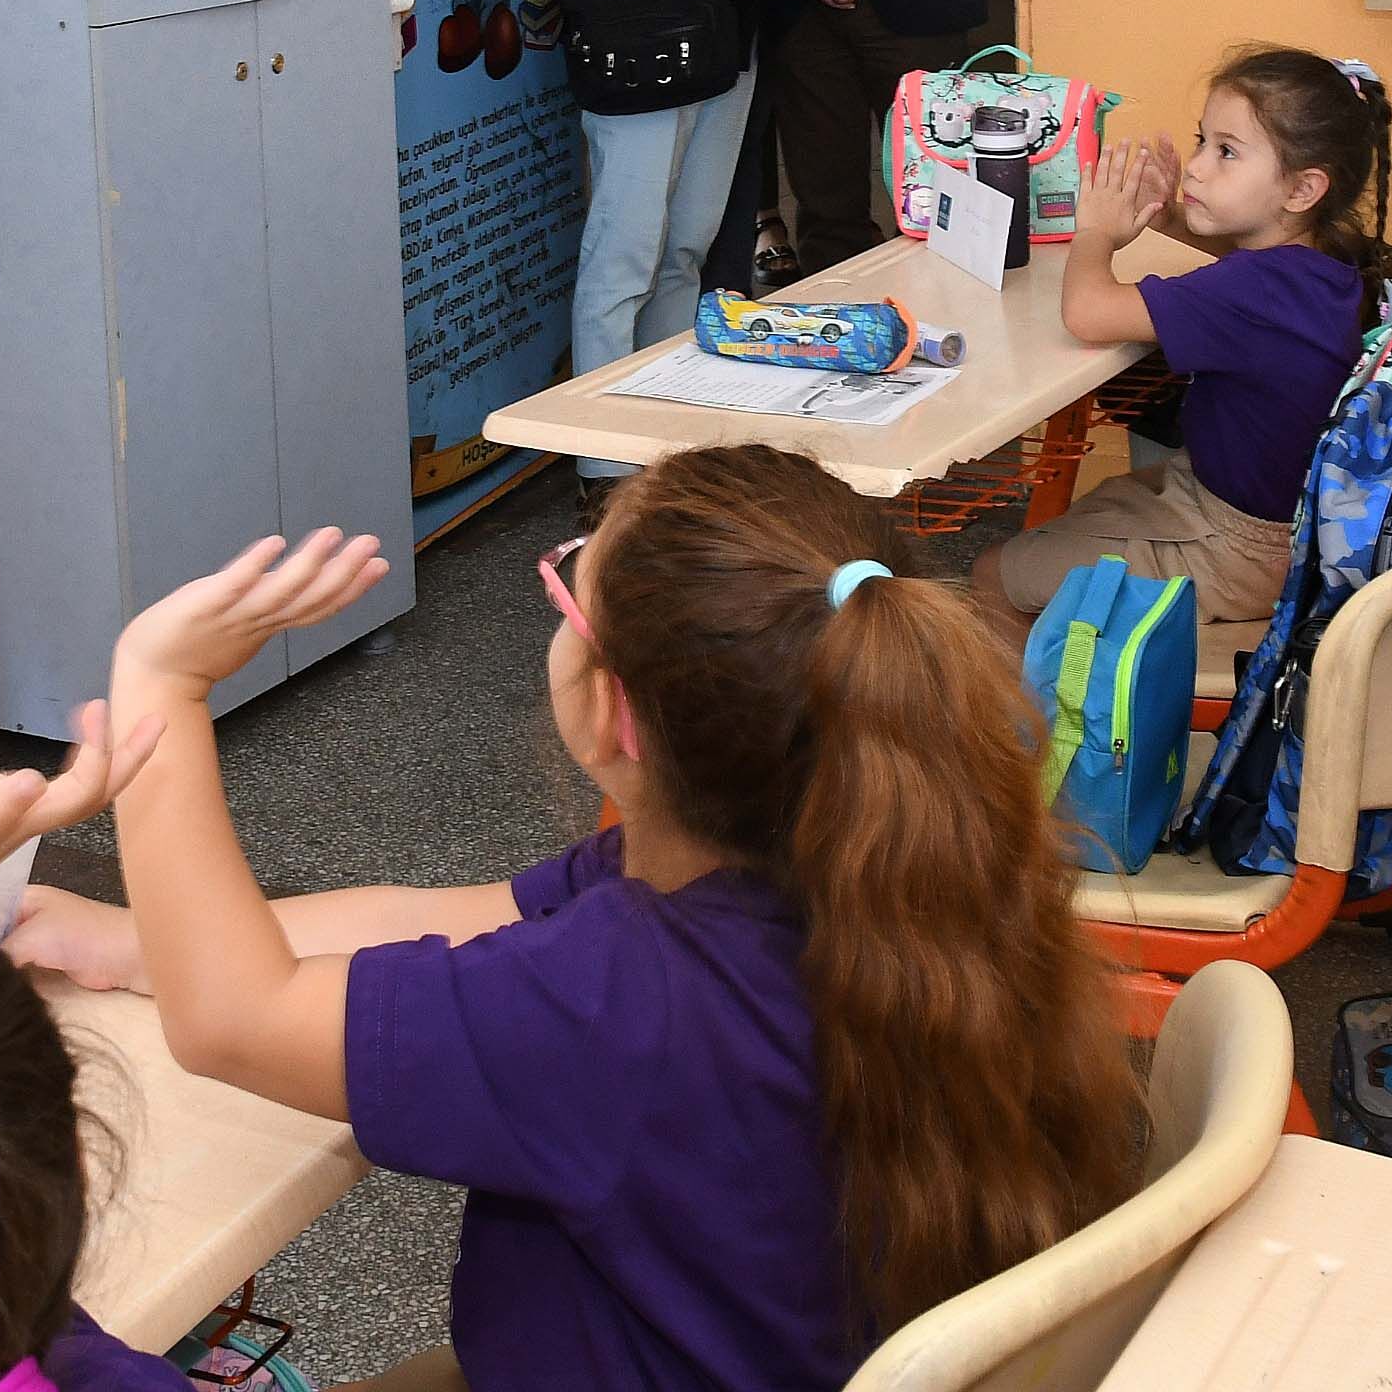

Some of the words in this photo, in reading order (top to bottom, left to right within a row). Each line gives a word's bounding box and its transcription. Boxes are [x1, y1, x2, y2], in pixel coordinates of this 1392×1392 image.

[412, 130, 455, 162] çocukken
[458, 116, 478, 140] uçak
[432, 145, 464, 174] telgraf
[468, 136, 483, 166] gibi
[426, 197, 459, 226] okumak
[463, 183, 490, 208] olduğu
[437, 223, 465, 247] Kimya
[432, 241, 471, 272] Profesör
[453, 259, 486, 286] rağmen
[433, 285, 475, 326] gelişmesi
[477, 276, 493, 298] için
[408, 355, 440, 385] sözünü
[443, 346, 459, 365] hep
[449, 348, 490, 389] gelişmesi
[490, 340, 508, 361] için
